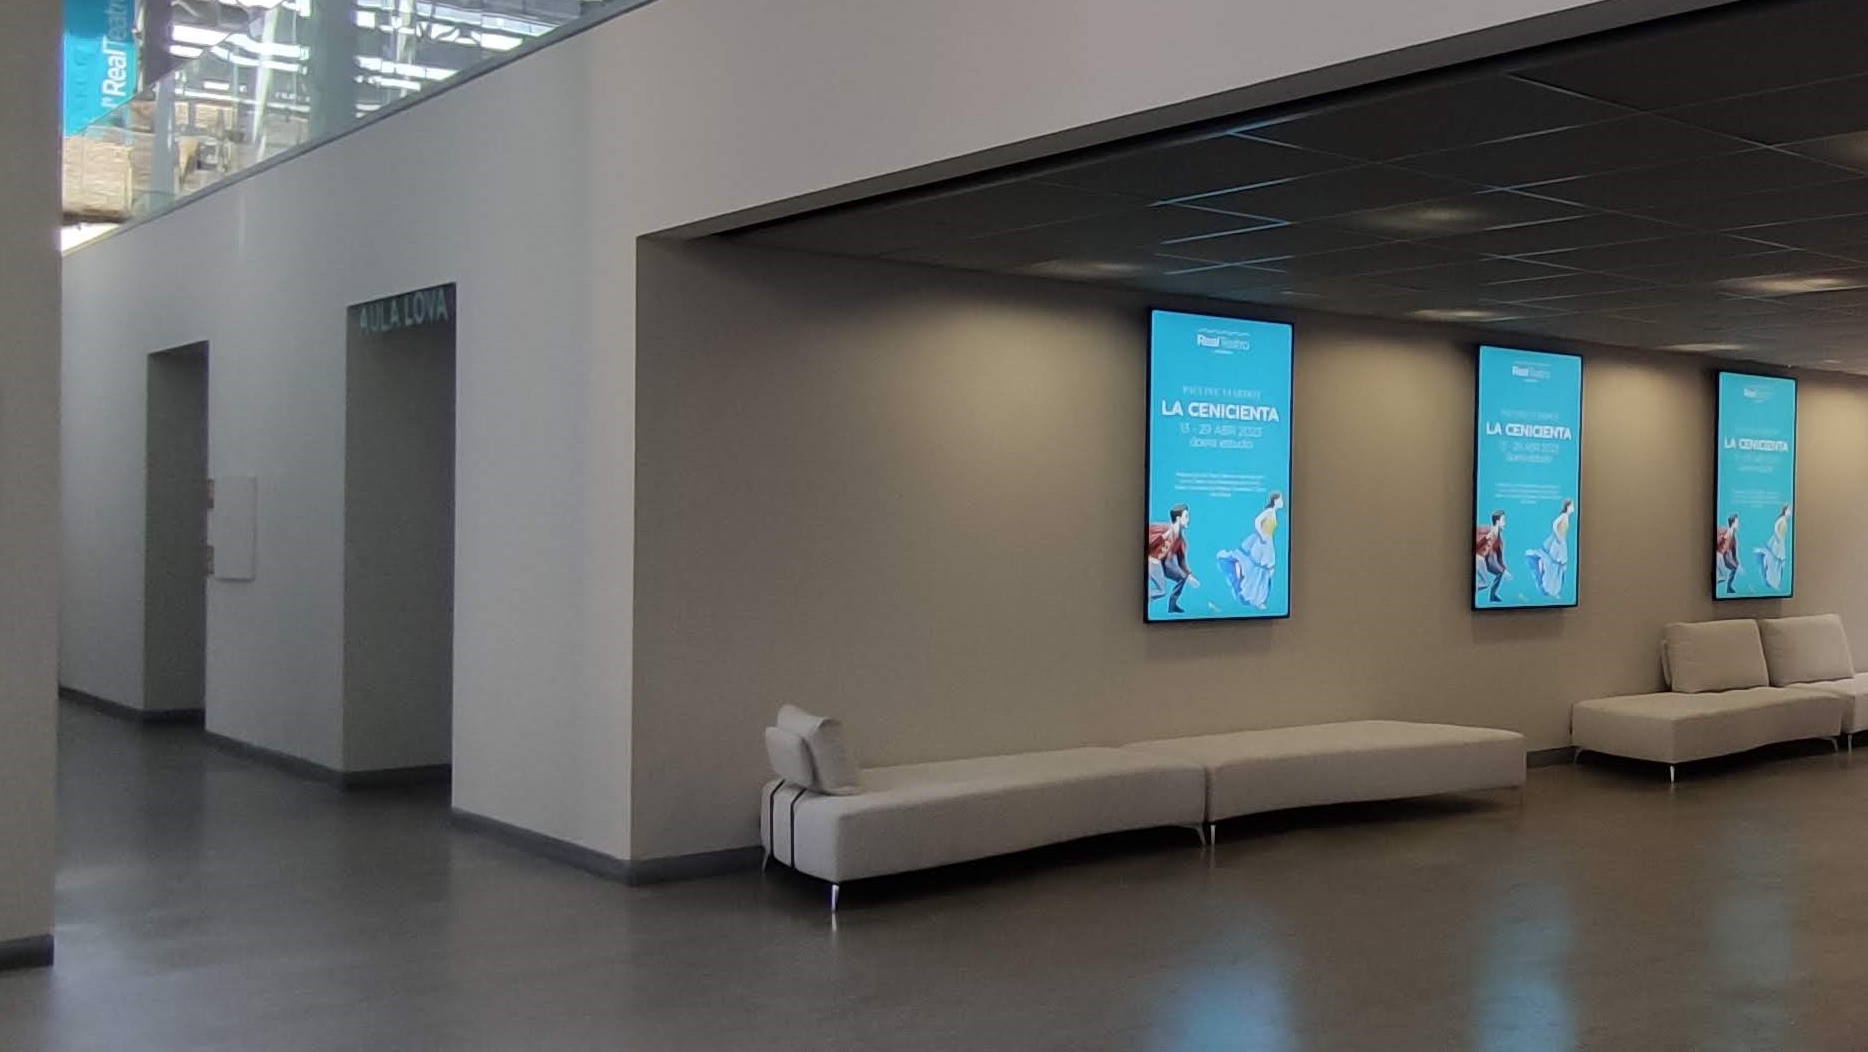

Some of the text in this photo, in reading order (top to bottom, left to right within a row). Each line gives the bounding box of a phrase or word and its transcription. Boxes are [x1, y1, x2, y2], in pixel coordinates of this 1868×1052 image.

[359, 288, 449, 336] AULA LOVA
[1161, 399, 1280, 422] LA CENICIENTA
[1486, 422, 1573, 440] LA CENICIENTA
[1723, 435, 1737, 449] LA
